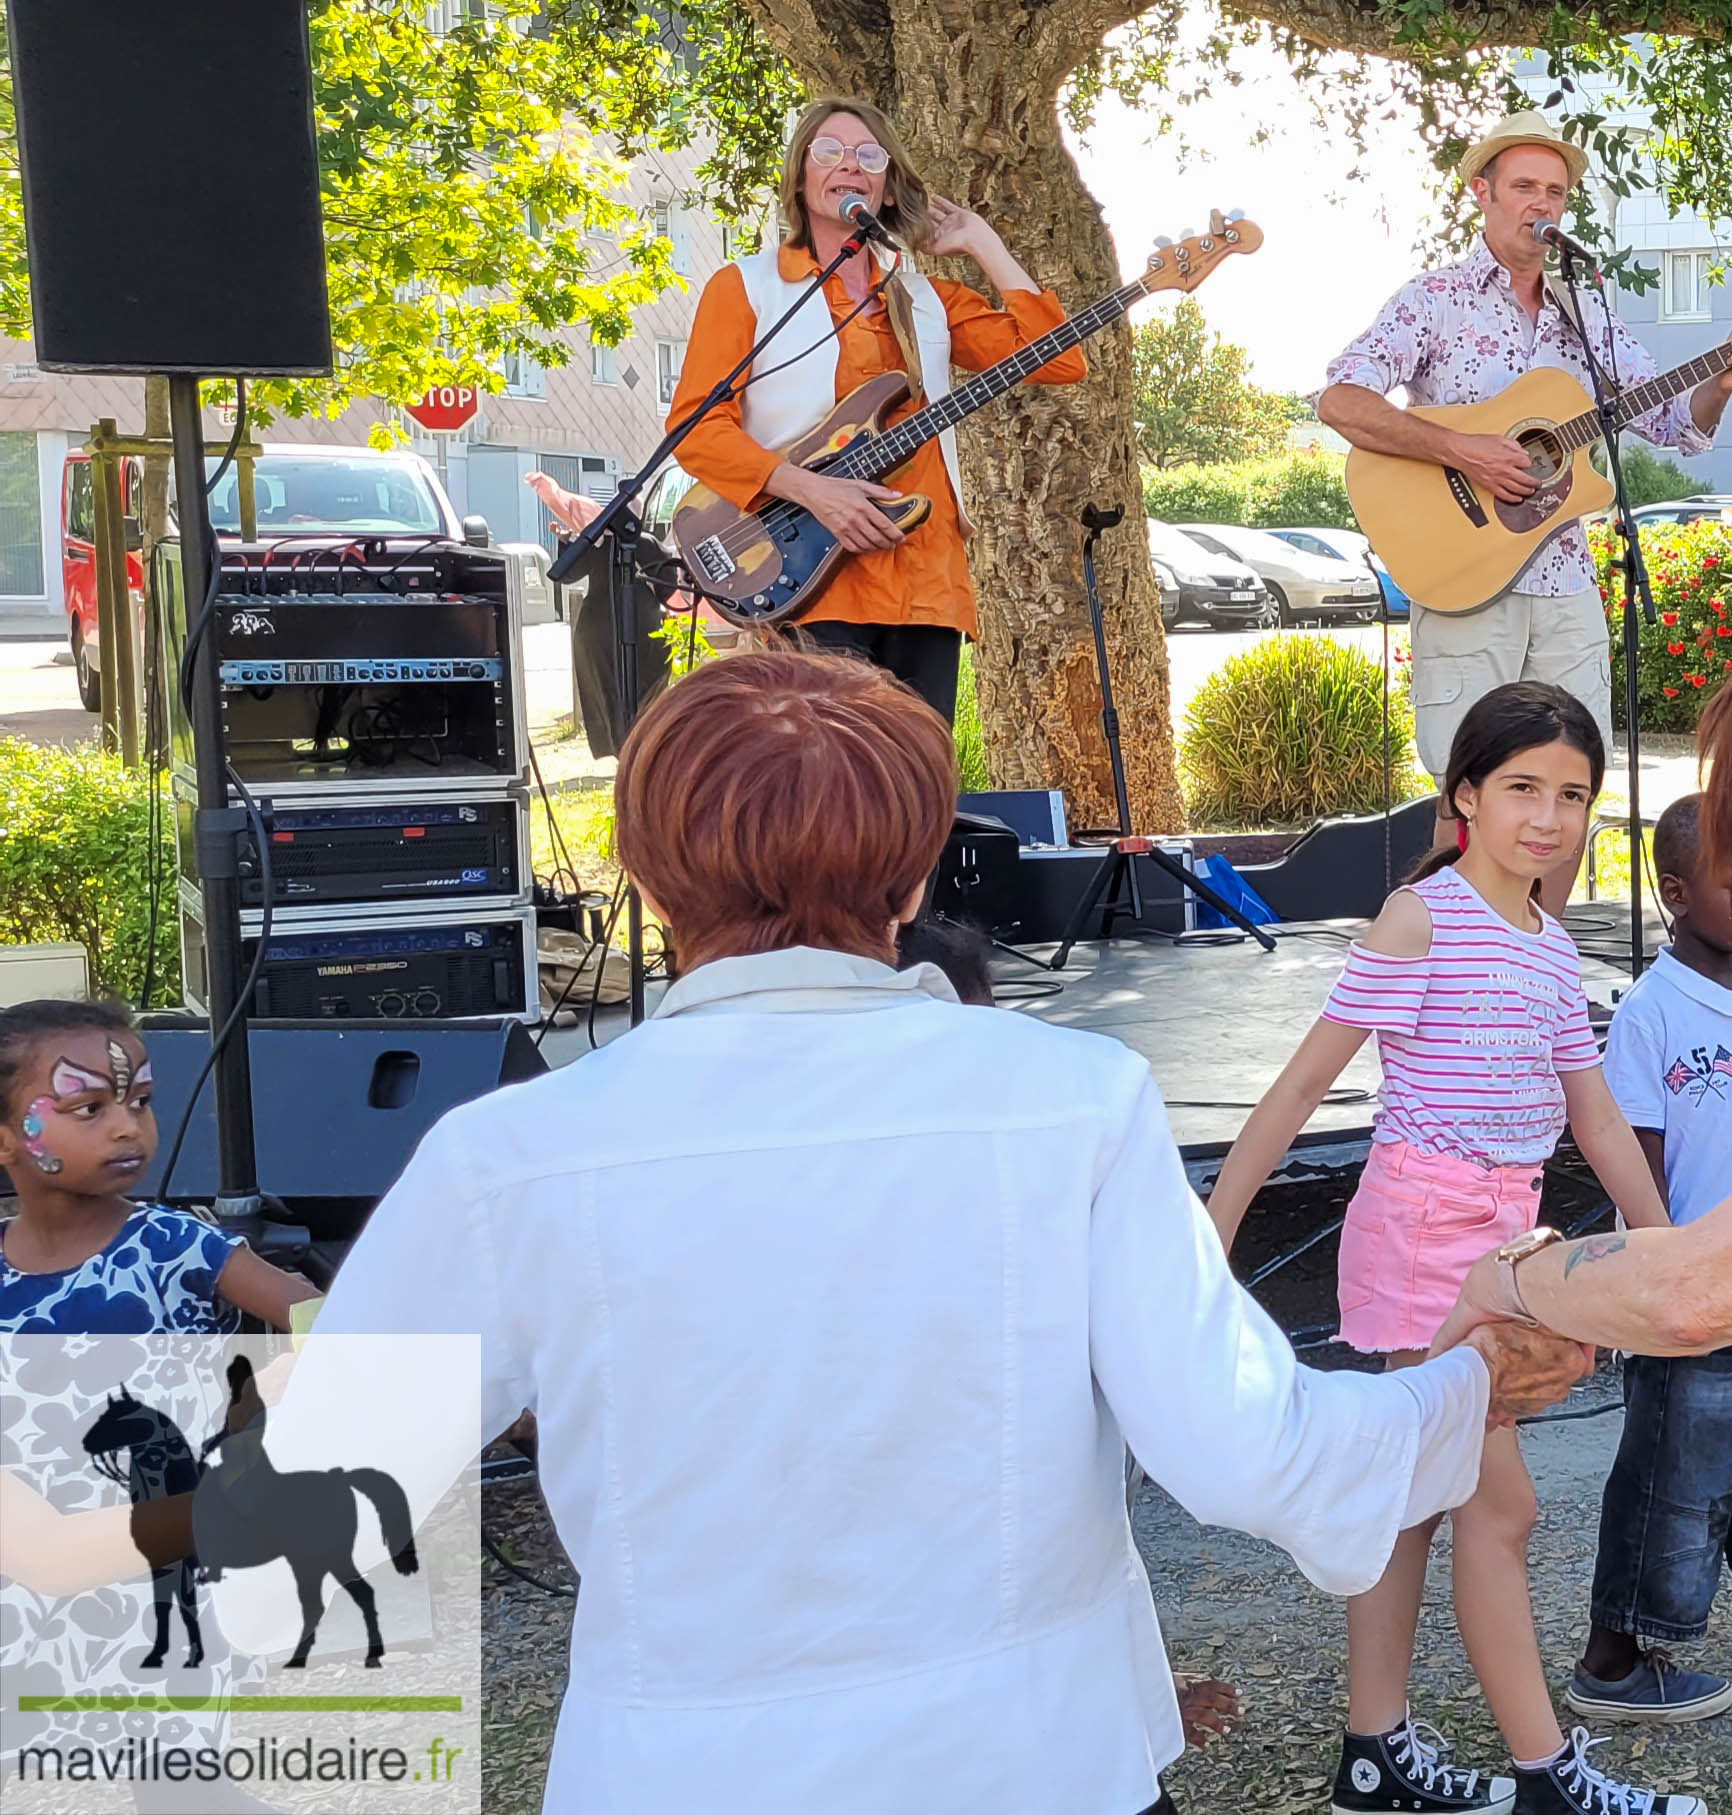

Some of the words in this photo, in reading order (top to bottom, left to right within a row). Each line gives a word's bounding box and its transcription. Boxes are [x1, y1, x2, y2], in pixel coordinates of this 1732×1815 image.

[410, 386, 473, 408] STOP
[461, 869, 487, 882] QSC
[316, 964, 354, 977] YAMAHA
[1460, 1030, 1510, 1048] ARMS
[1690, 1046, 1712, 1076] 5
